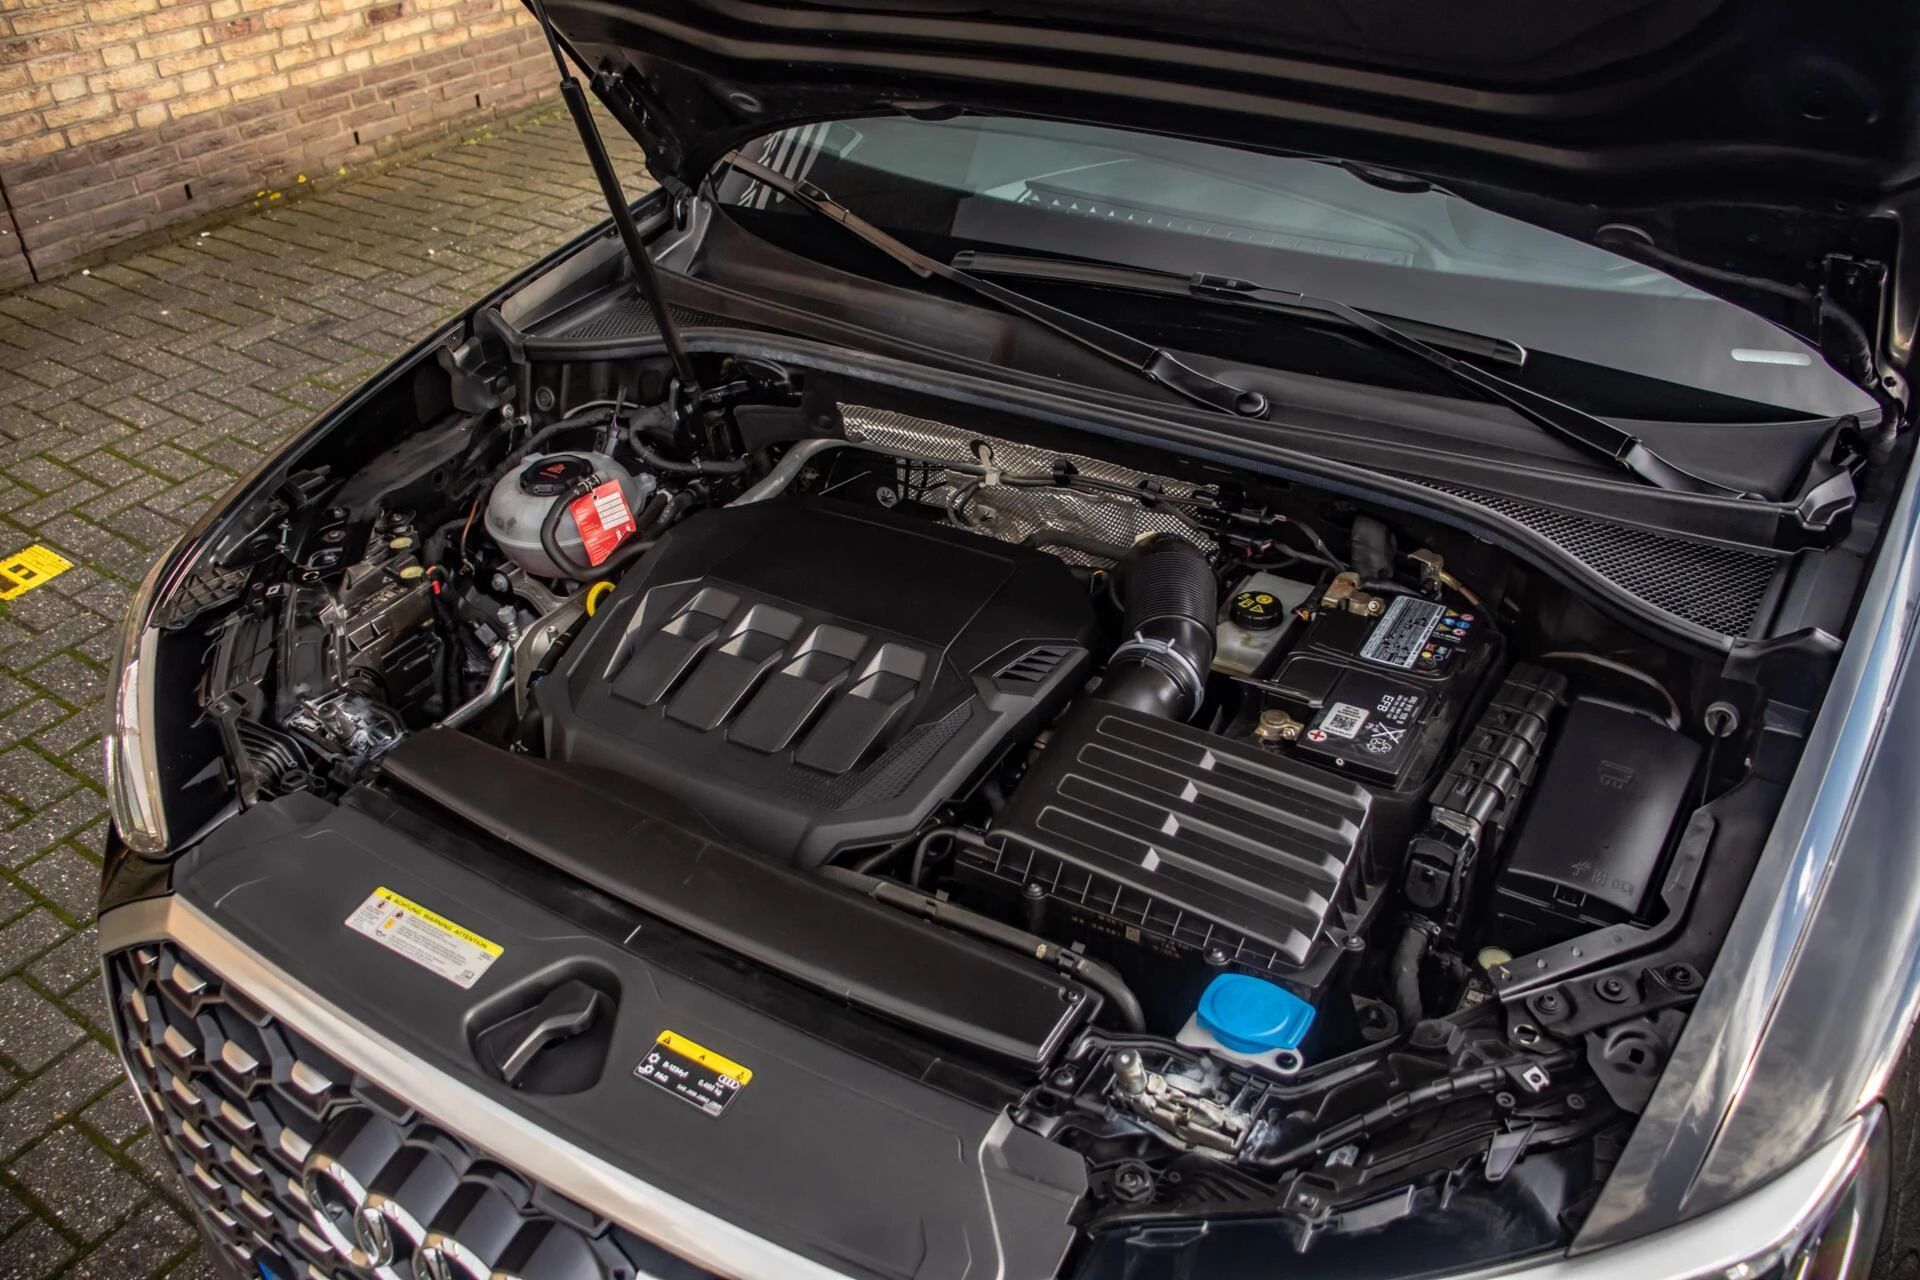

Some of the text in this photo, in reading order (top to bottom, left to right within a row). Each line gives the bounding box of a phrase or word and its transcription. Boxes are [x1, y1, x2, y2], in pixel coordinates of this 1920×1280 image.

[1376, 694, 1395, 712] EFB
[394, 898, 488, 949] ACHTUNG WARNING ATTENTION
